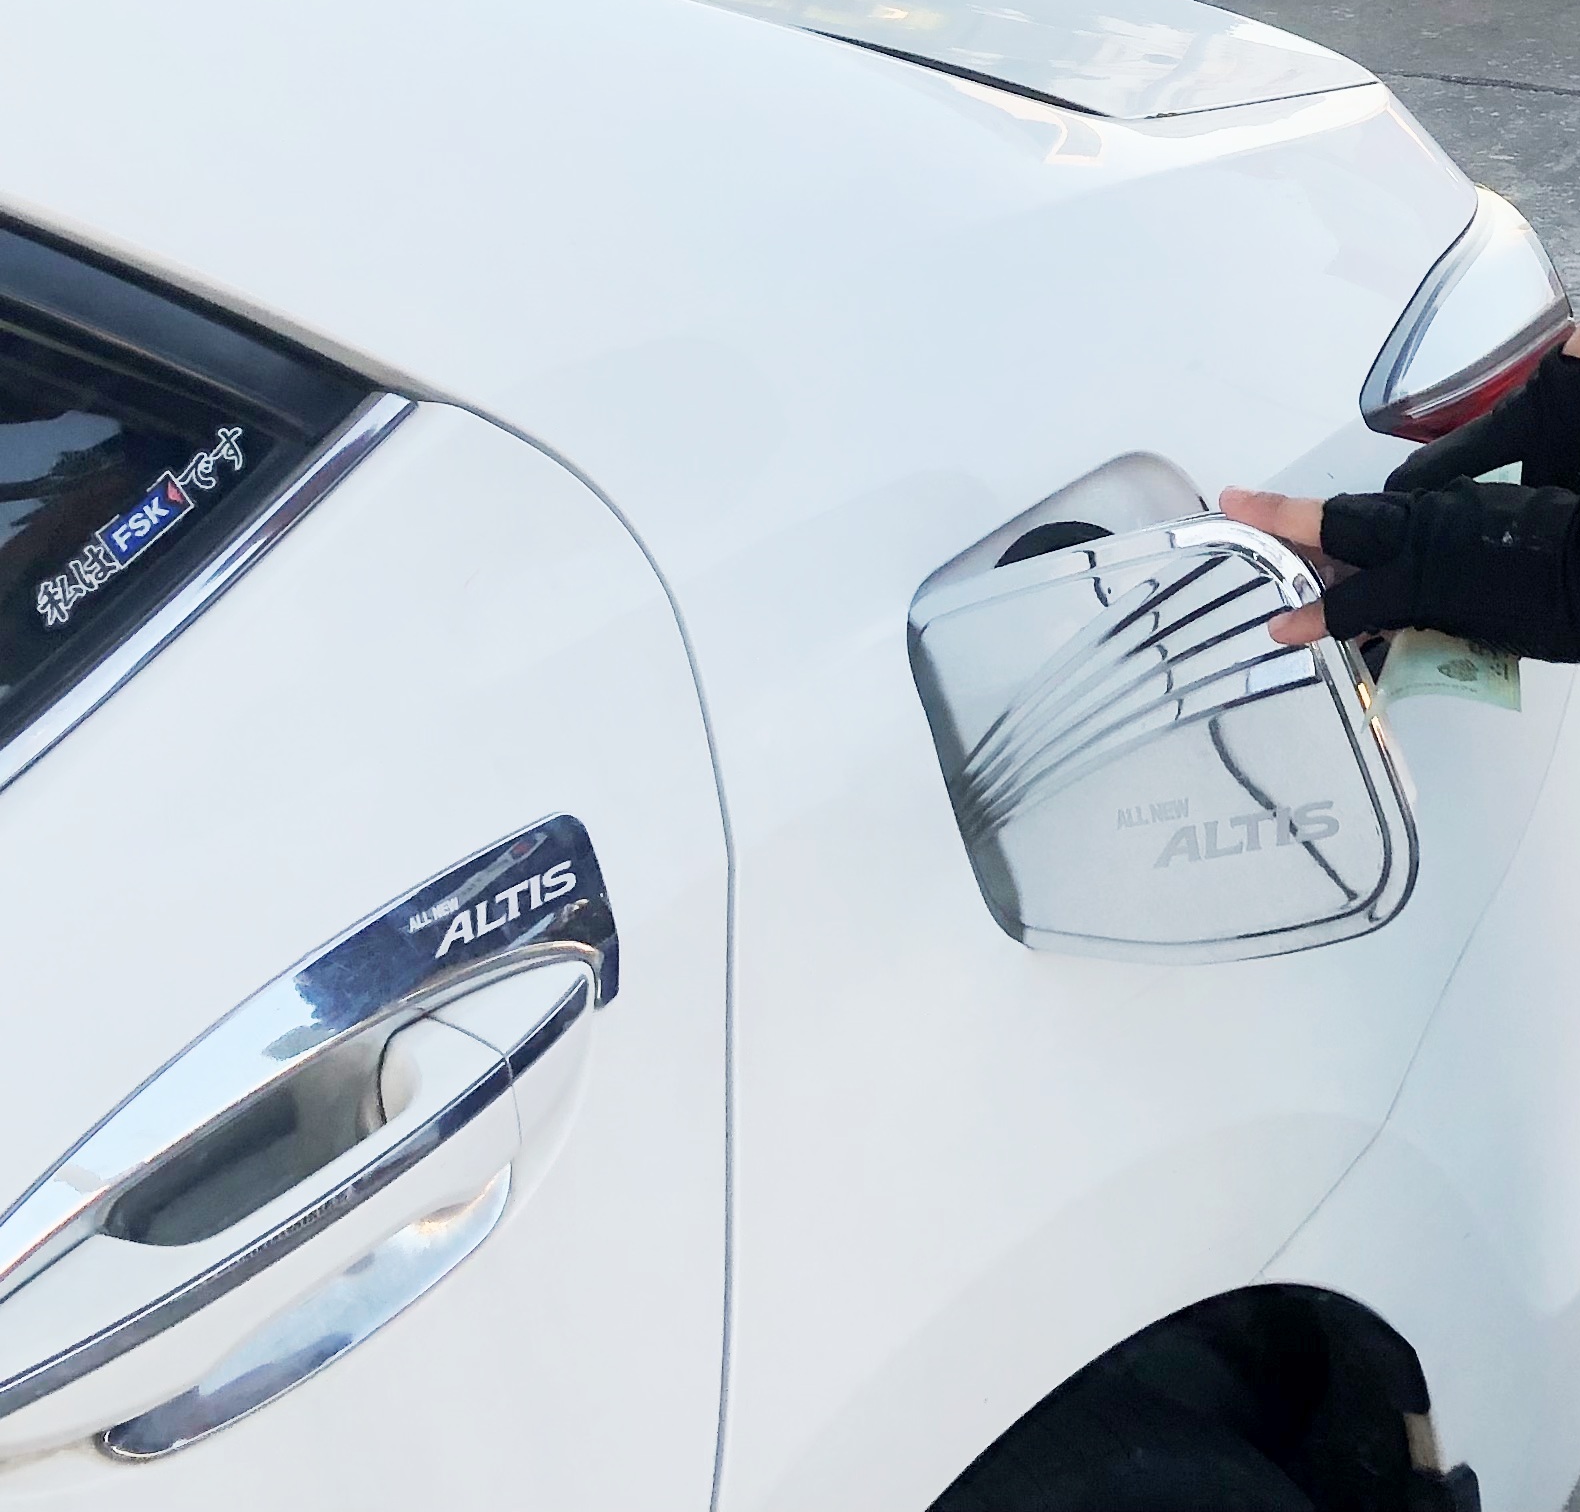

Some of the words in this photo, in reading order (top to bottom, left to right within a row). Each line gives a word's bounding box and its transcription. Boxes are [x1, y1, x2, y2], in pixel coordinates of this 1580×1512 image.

[37, 544, 119, 625] 私は
[111, 497, 170, 552] FSK
[177, 426, 244, 490] です
[1116, 807, 1149, 830] ALL
[1149, 798, 1189, 822] NEW
[1153, 800, 1340, 869] ALTIS
[409, 911, 433, 934] ALL
[432, 897, 460, 920] NEW
[435, 860, 577, 959] ALTIS
